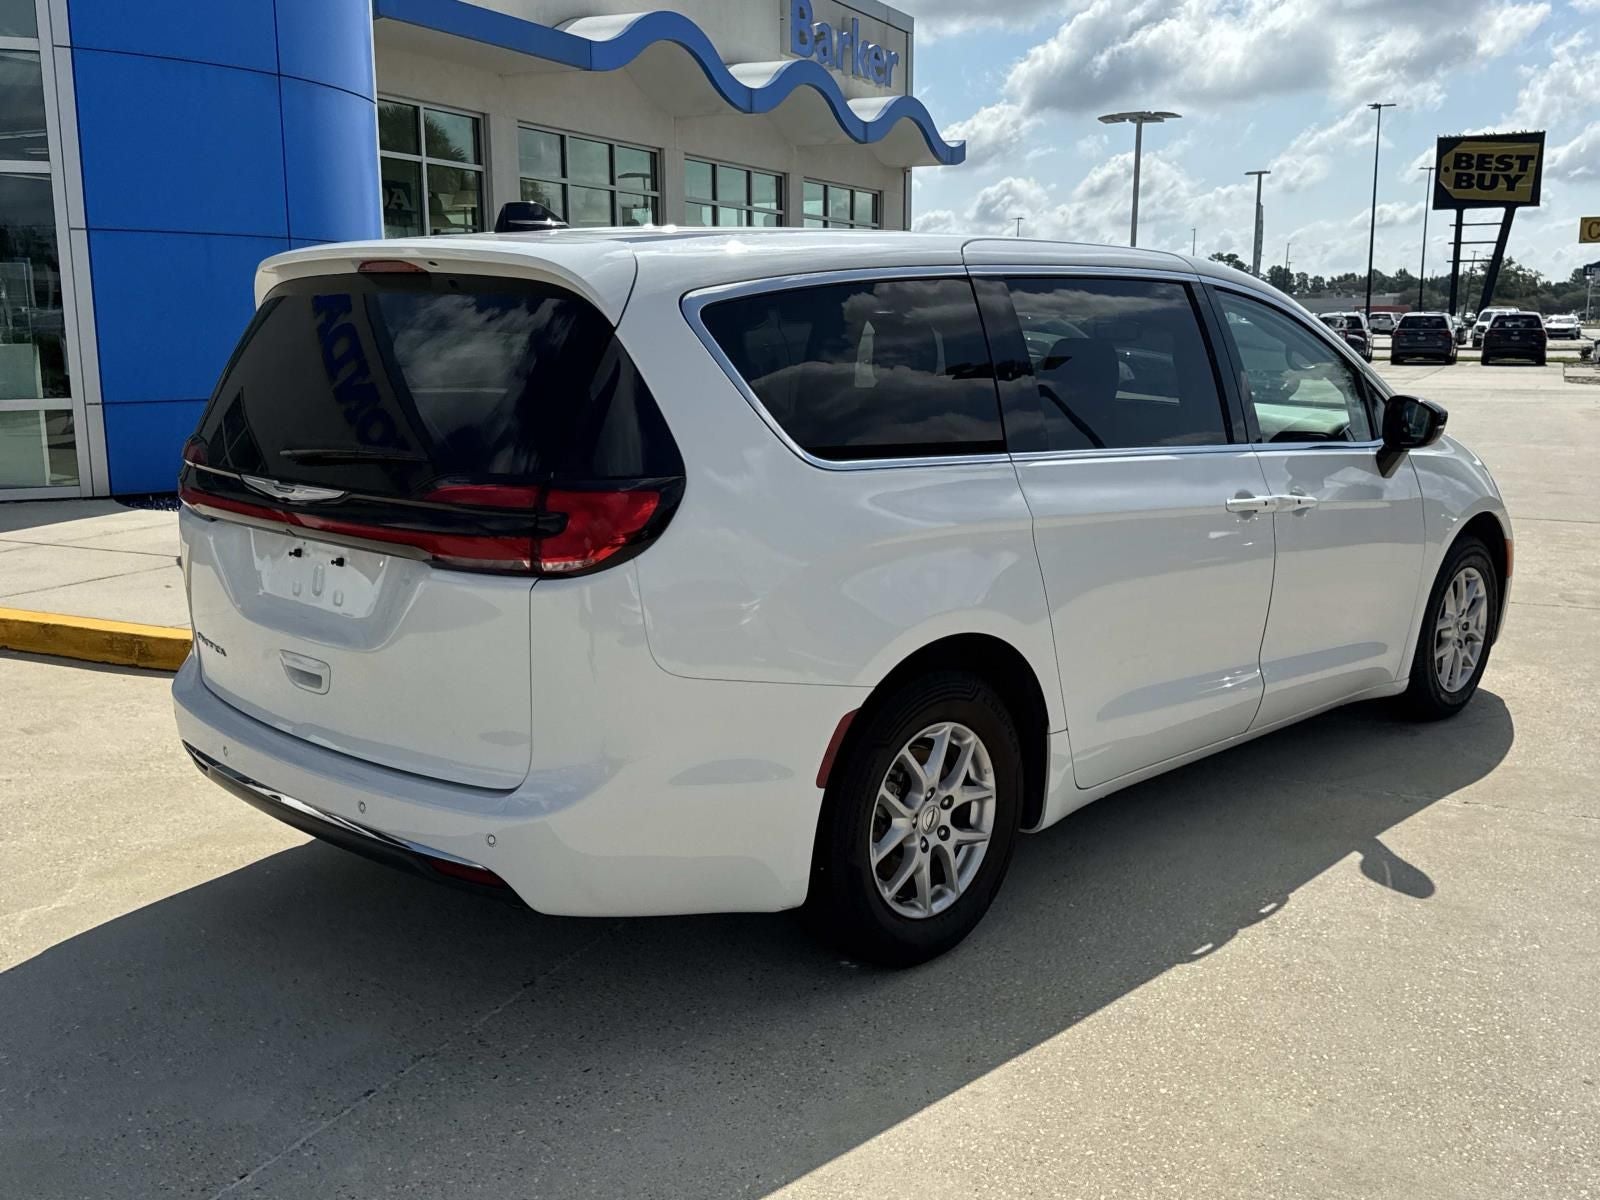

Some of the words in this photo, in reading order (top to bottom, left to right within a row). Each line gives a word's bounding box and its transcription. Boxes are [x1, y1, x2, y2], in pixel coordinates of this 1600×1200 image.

[791, 0, 899, 88] Barker
[1452, 152, 1535, 173] BEST
[1452, 172, 1525, 192] BUY
